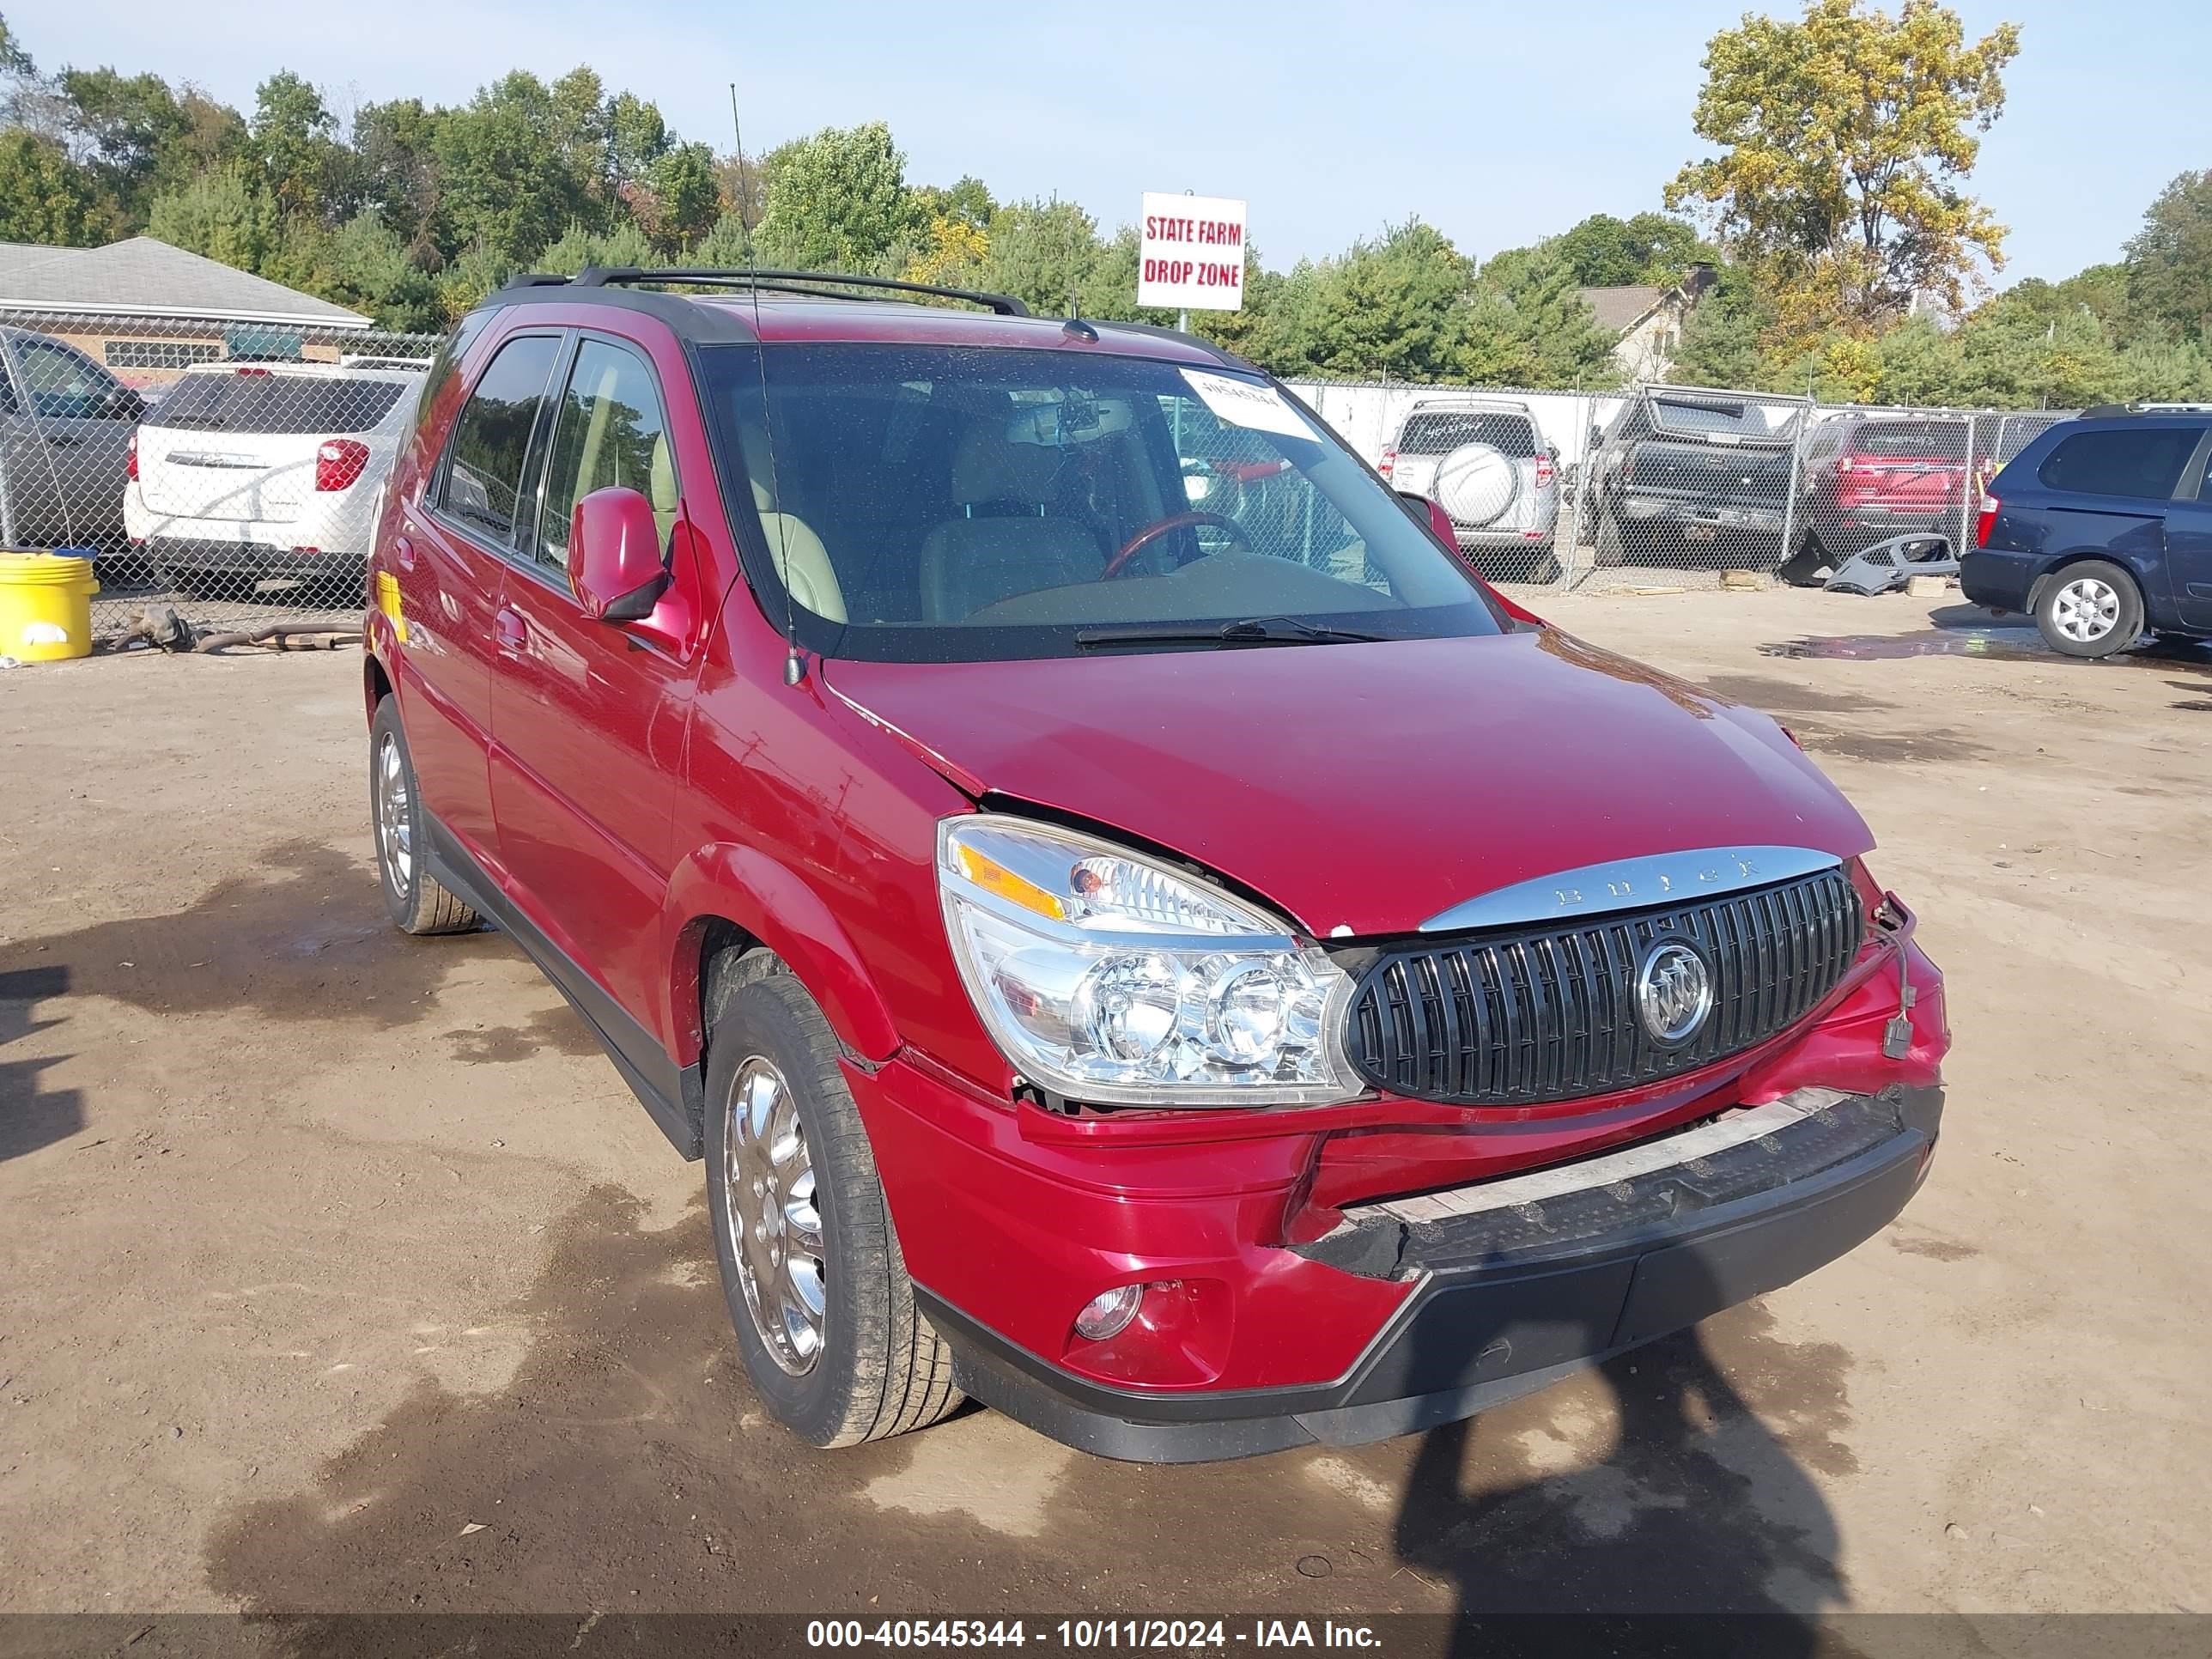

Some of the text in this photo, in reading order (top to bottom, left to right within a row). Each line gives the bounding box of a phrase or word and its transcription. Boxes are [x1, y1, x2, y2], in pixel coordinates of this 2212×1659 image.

[1146, 216, 1242, 246] STATE FARM
[1144, 258, 1239, 288] DROP ZONE
[1555, 860, 1761, 907] BUICK
